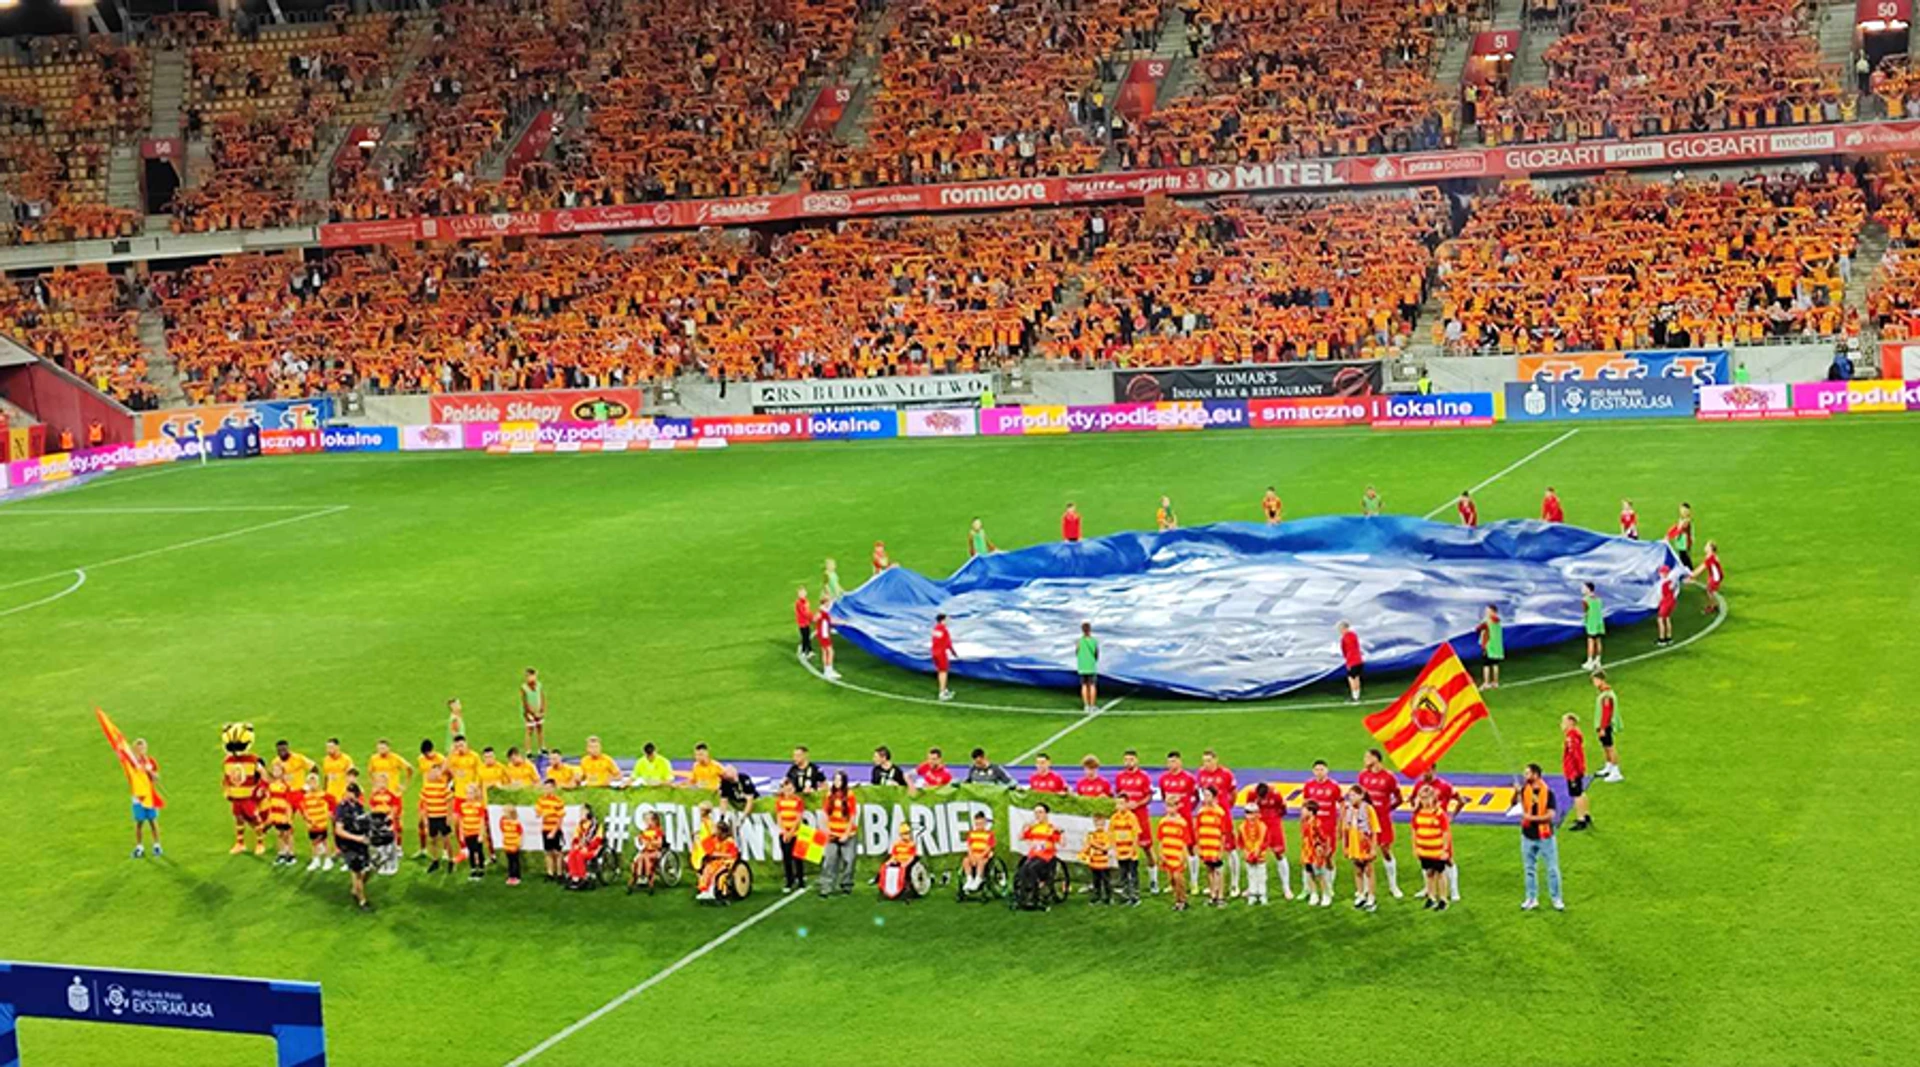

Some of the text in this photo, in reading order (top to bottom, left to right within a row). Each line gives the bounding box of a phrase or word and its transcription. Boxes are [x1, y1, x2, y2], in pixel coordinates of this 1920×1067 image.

[1877, 1, 1898, 17] 50
[1493, 34, 1508, 49] 51
[1147, 62, 1164, 77] 52
[835, 88, 851, 102] 53
[366, 127, 382, 140] 55
[1505, 141, 1654, 169] GLOBART print
[1667, 132, 1829, 158] GLOBART media
[1234, 162, 1345, 190] MITEL
[940, 183, 1046, 205] romicore
[778, 376, 982, 401] RS BUDOWNICTWO
[1215, 371, 1278, 387] KUMAR'S
[1173, 384, 1323, 399] INDIAN BAR & RESTAURANT
[441, 404, 500, 422] Polskie
[506, 402, 562, 422] Sklepy
[1000, 402, 1242, 430] produkty.podlaskie.eu
[1262, 402, 1365, 421] smaczne
[1385, 396, 1473, 418] lokalne
[1590, 395, 1674, 411] EKSTRAKLASA
[320, 425, 383, 447] lokalne
[481, 420, 686, 445] produkty.podlaskie.eu
[703, 417, 791, 437] smaczne
[808, 411, 881, 434] lokalne
[131, 998, 215, 1018] EKSTRAKLASA
